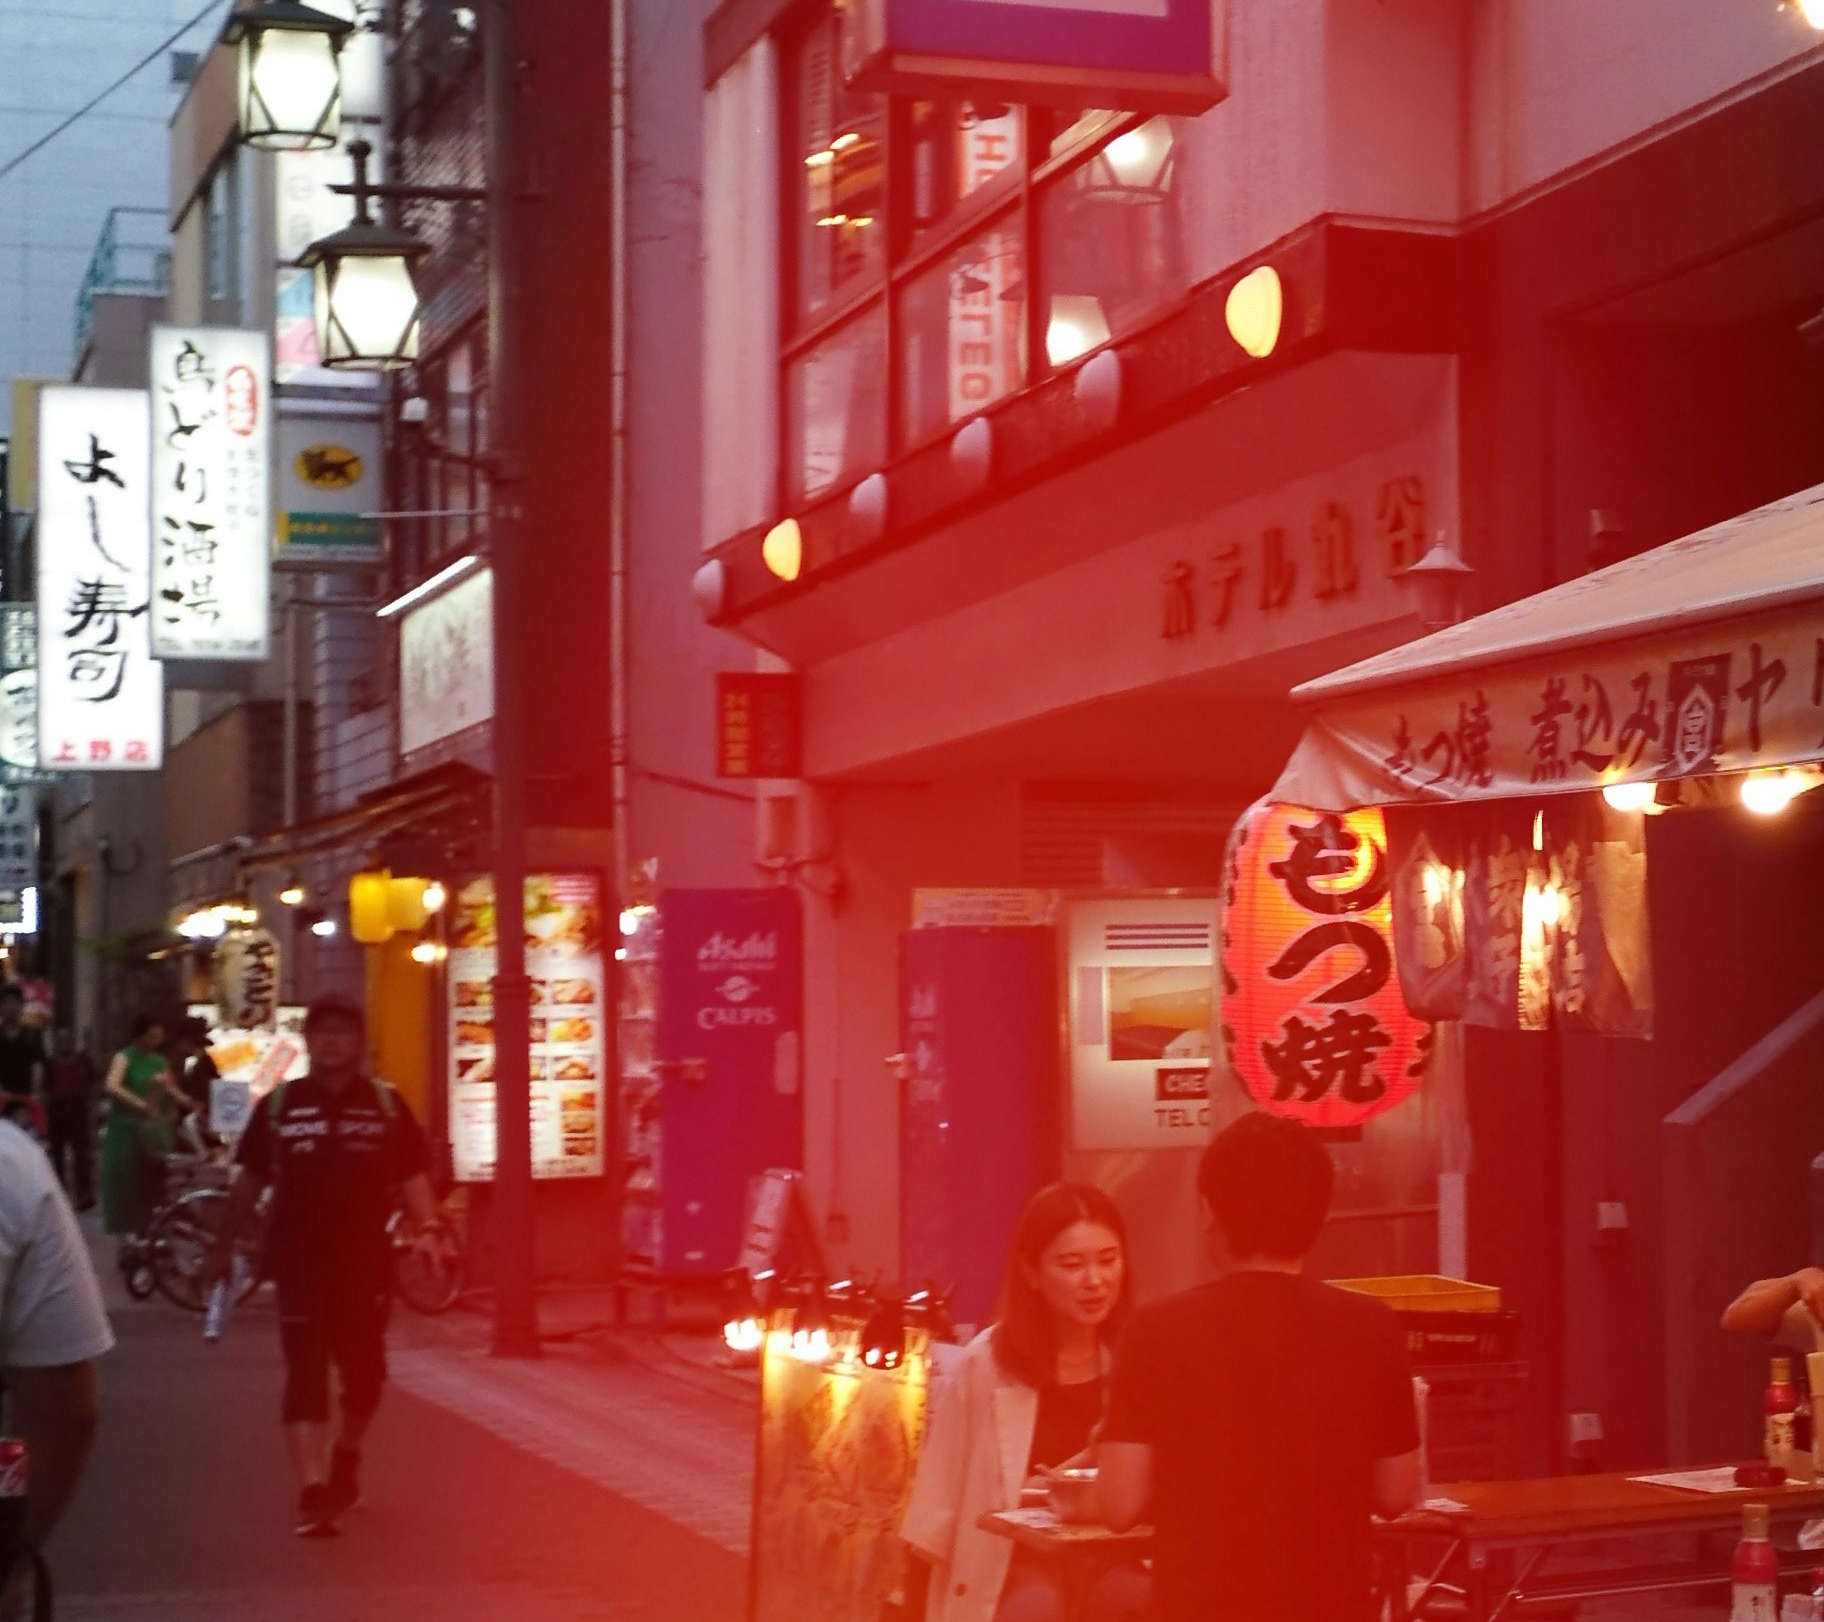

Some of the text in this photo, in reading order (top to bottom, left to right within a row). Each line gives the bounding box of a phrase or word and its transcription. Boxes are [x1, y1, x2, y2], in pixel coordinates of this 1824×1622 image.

[62, 432, 149, 704] よし寿司
[50, 739, 150, 763] 上野店
[696, 929, 778, 960] Asahi
[1260, 813, 1394, 1103] もつ焼
[696, 1006, 778, 1032] CALPIS
[1154, 1107, 1195, 1127] TEL
